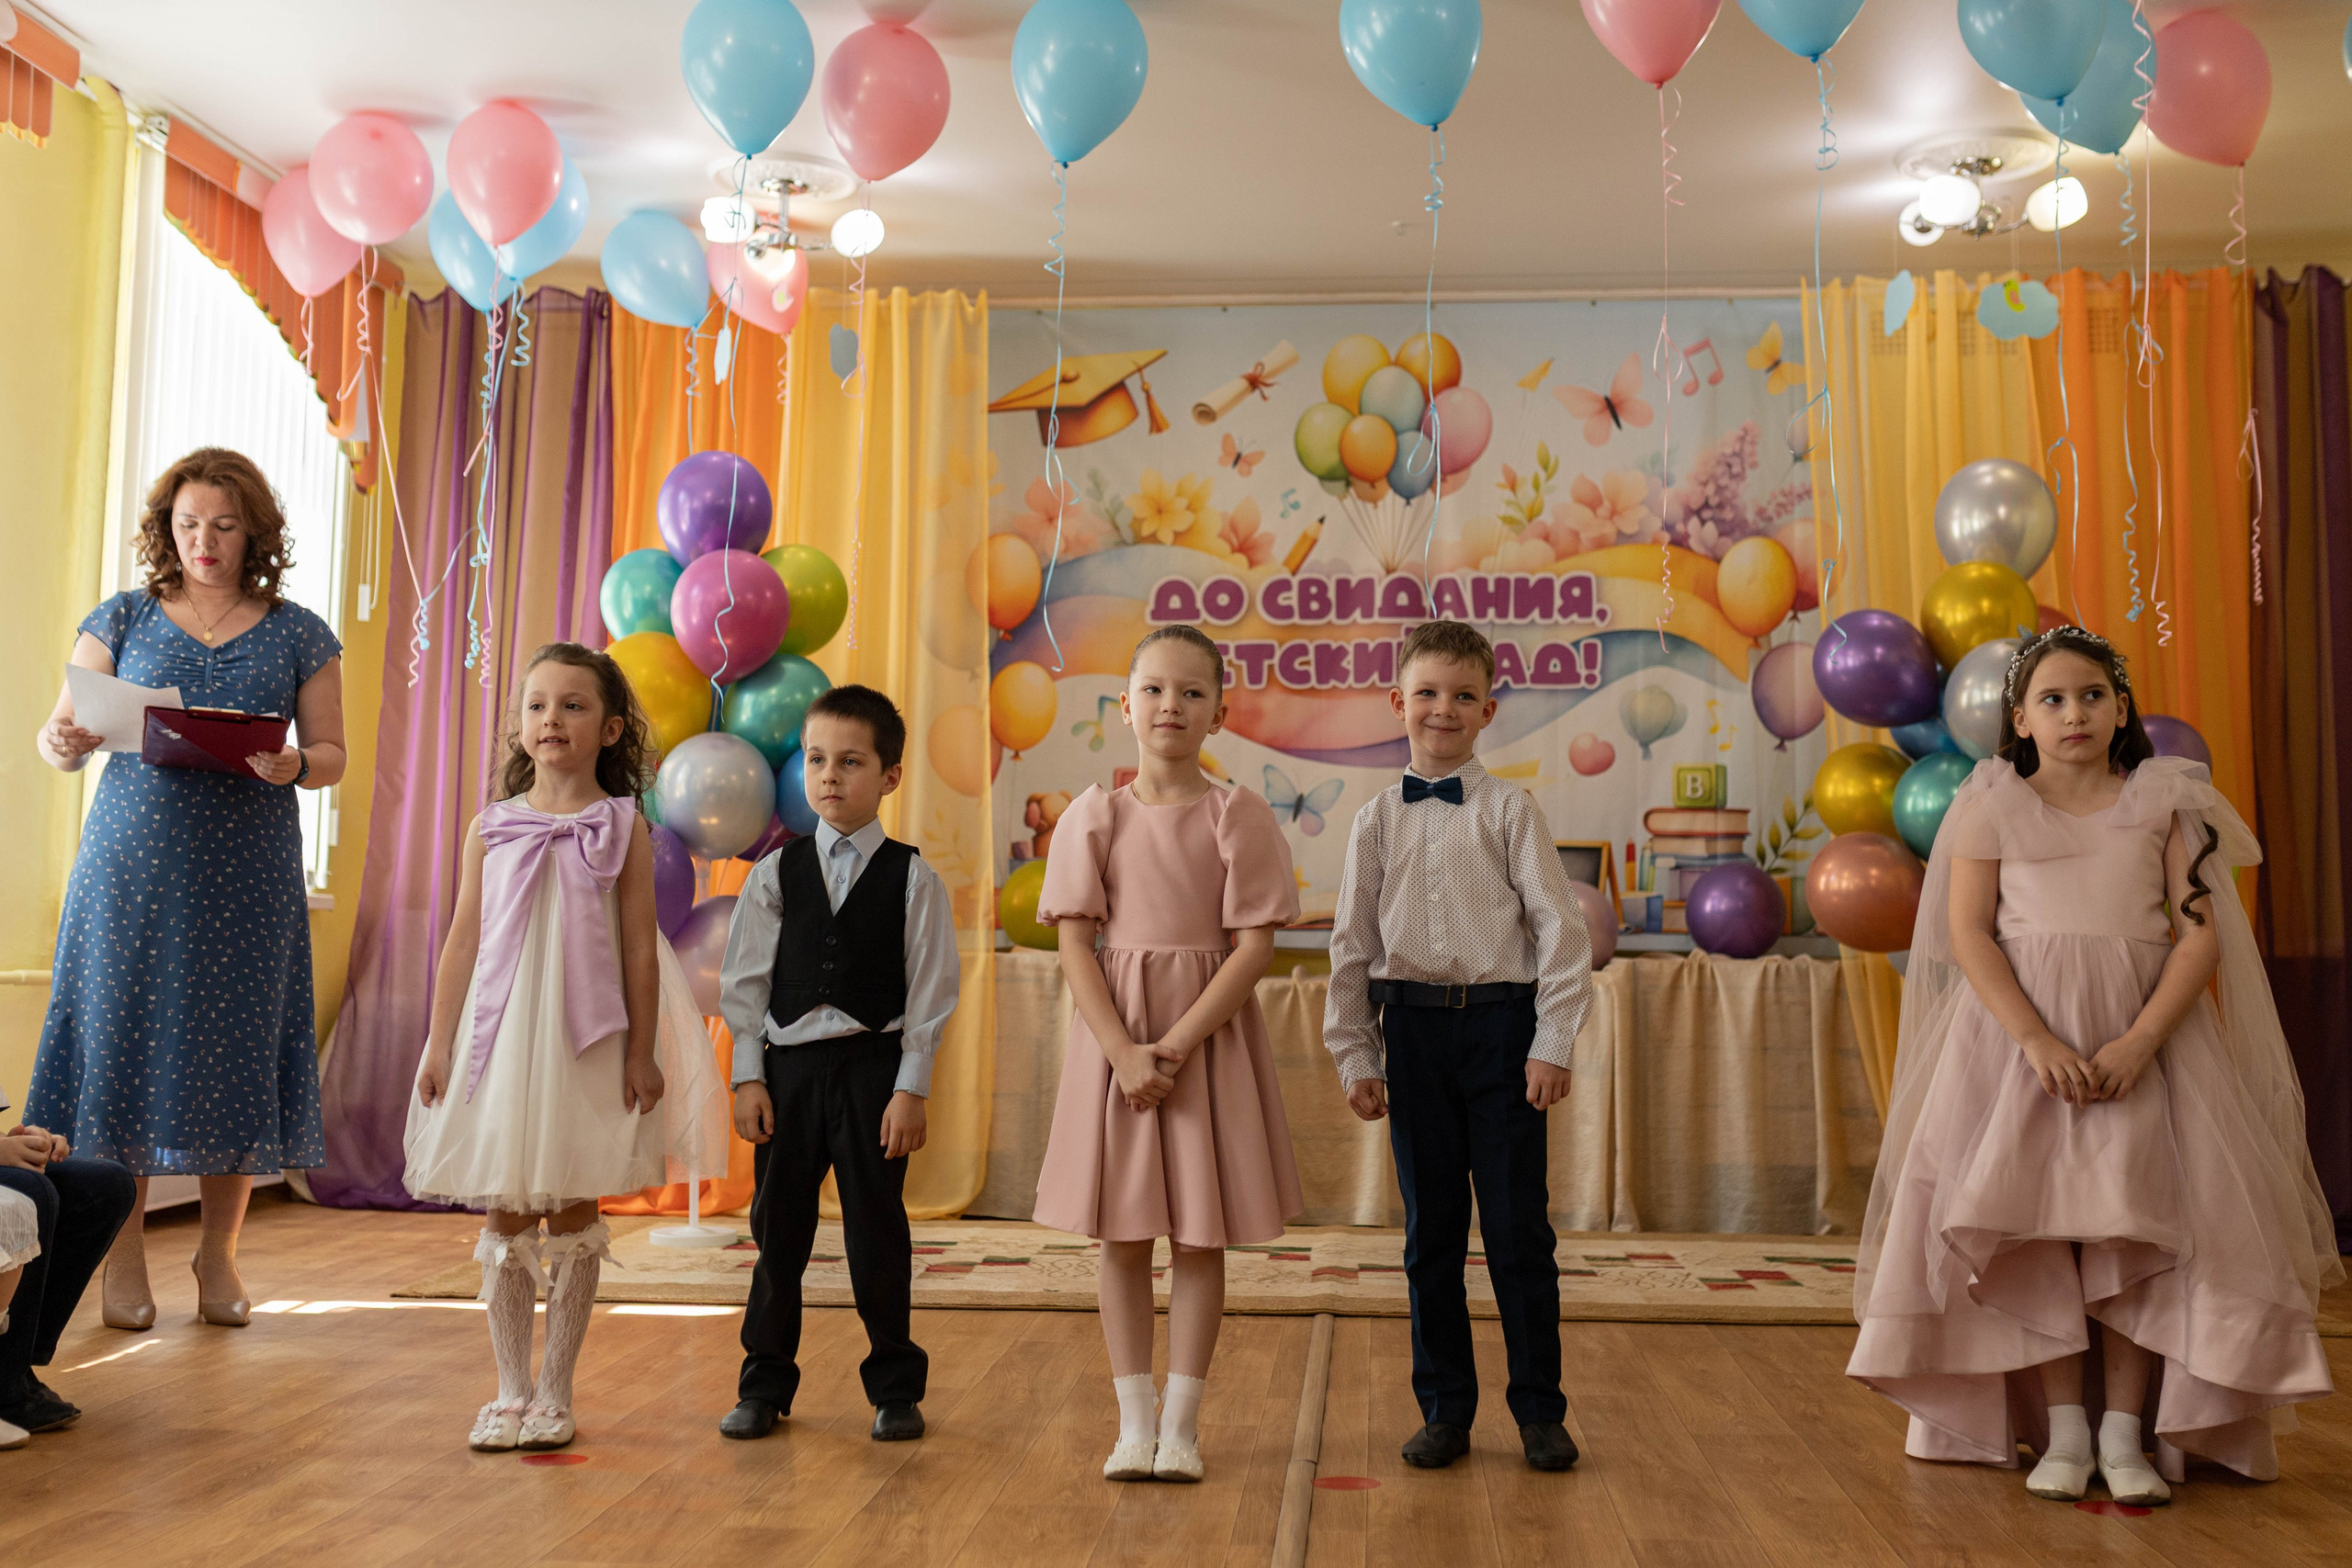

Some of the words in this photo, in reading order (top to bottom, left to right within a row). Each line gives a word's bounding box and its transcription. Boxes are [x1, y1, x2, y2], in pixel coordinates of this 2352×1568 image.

[1148, 574, 1250, 625] ДО
[1257, 571, 1611, 626] СВИДАНИЯ,
[1214, 626, 1416, 690] ТСКИ
[1488, 639, 1601, 689] АД!
